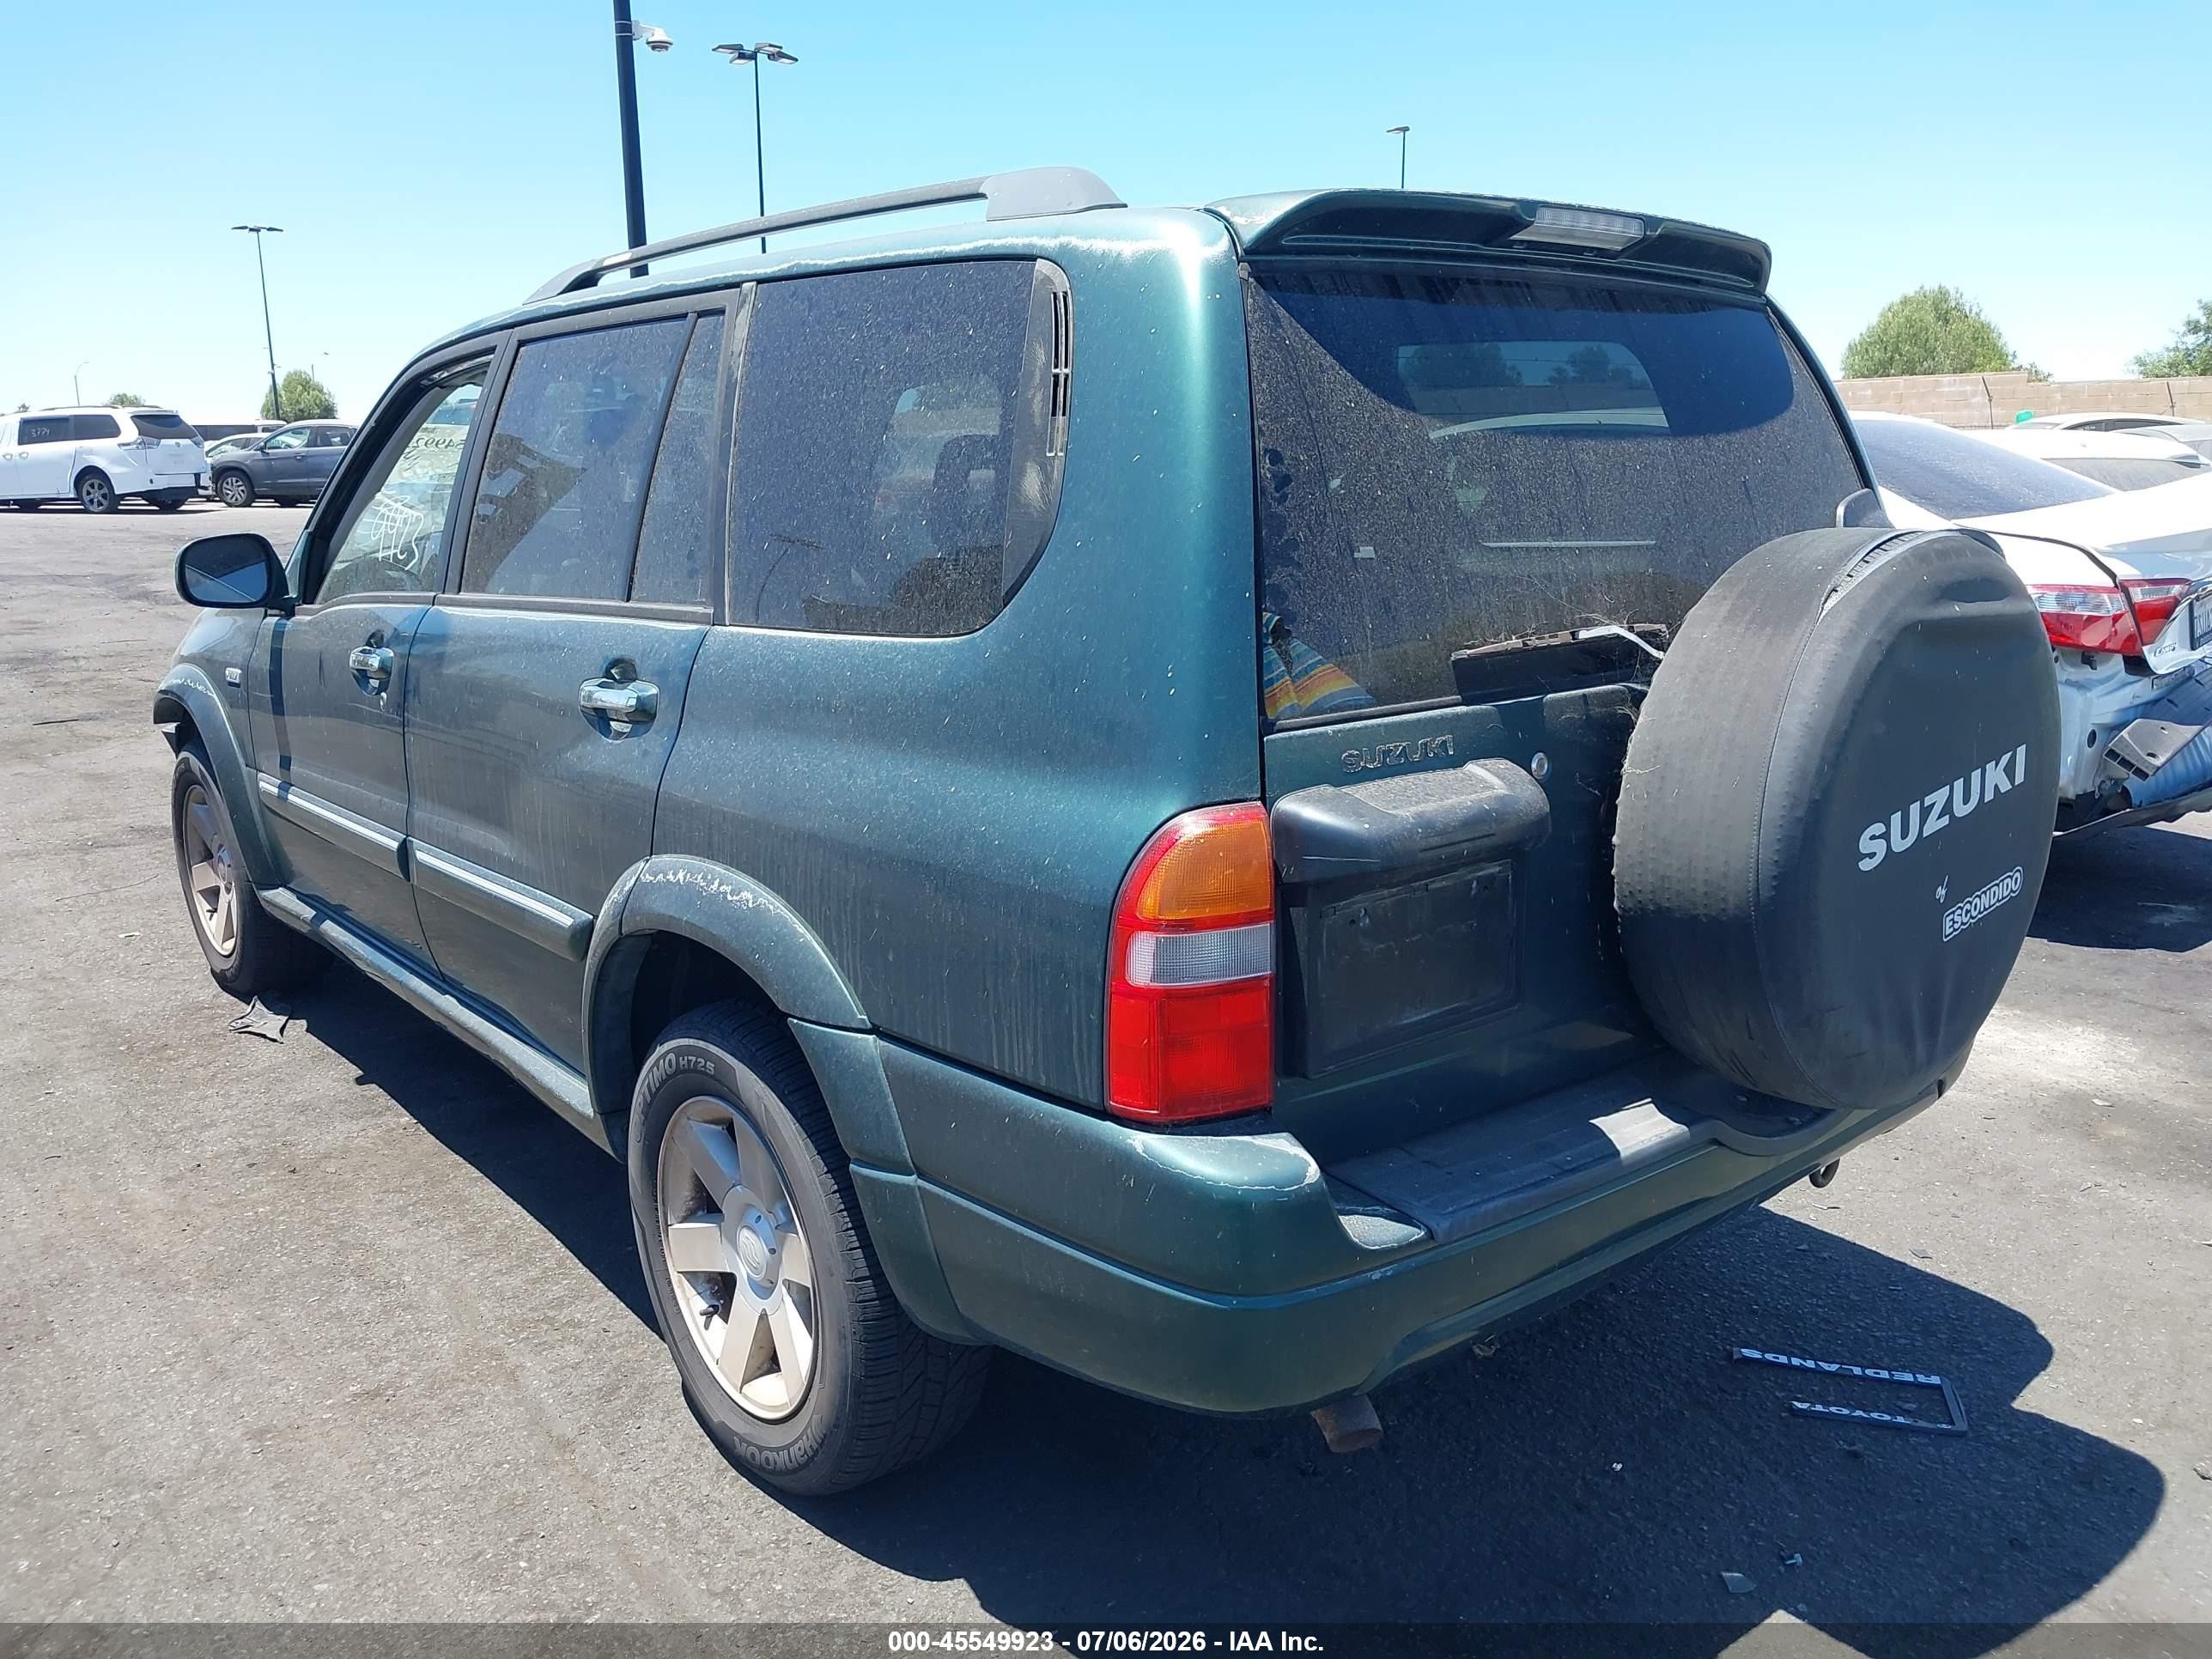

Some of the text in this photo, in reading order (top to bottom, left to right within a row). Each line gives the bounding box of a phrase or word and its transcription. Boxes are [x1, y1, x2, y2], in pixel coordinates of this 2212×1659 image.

[1341, 734, 1454, 773] SUZUKI
[1858, 744, 2027, 872] SUZUKI
[1944, 868, 2022, 938] ESCONDIDO
[635, 1052, 715, 1143] OPTIMO H725
[1740, 1348, 1942, 1384] REDLANDS
[1791, 1401, 1911, 1424] TOYOTA
